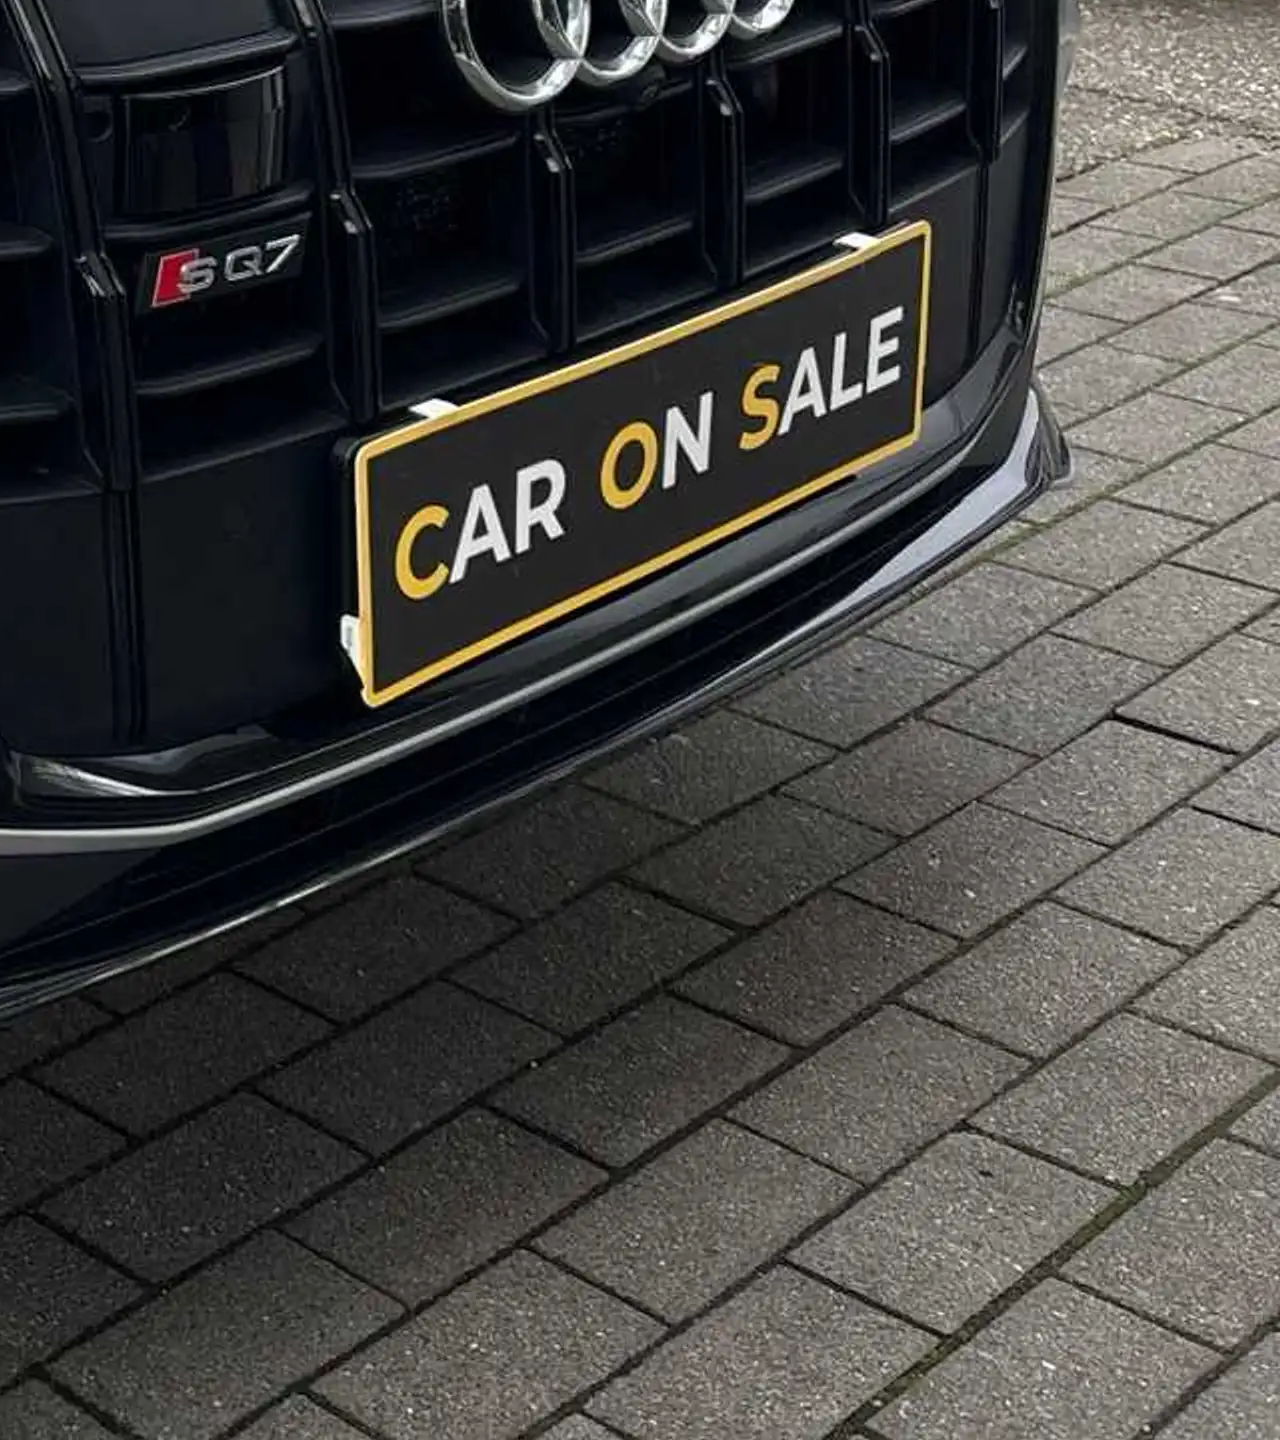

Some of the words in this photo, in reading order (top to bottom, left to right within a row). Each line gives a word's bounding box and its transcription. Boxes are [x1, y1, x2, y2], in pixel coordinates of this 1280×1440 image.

[176, 233, 301, 295] SQ7
[394, 458, 567, 601] CAR
[599, 391, 715, 510] ON
[739, 306, 904, 451] SALE
